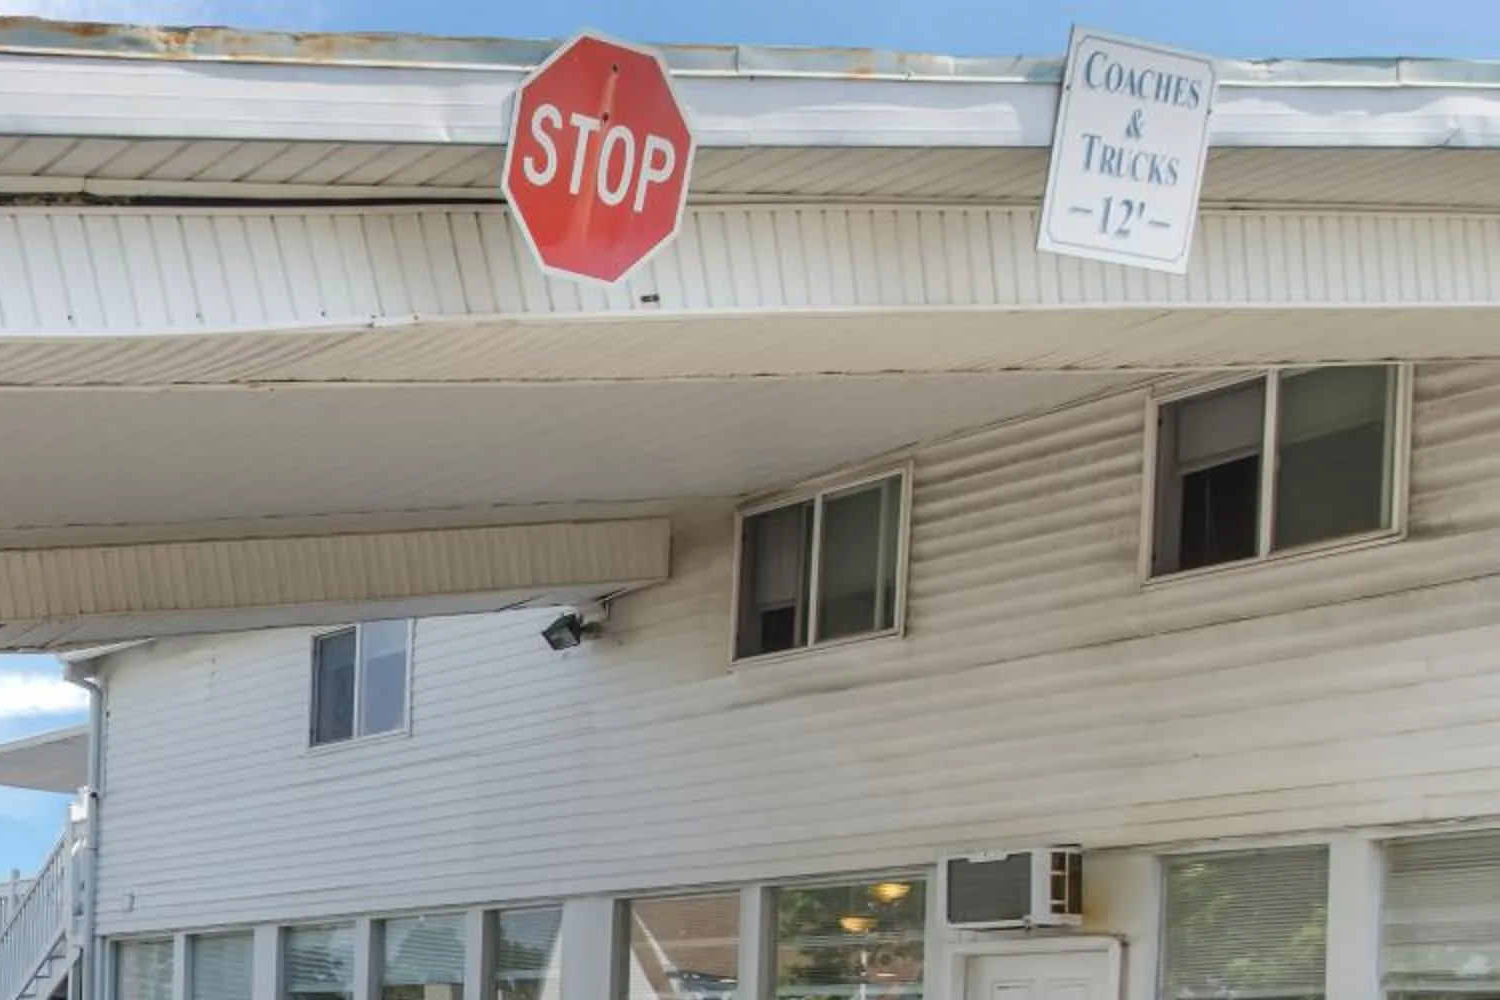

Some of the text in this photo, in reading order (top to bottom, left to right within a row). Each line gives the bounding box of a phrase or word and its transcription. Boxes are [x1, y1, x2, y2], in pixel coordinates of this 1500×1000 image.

[1085, 51, 1201, 109] COACHES
[1125, 109, 1144, 140] &
[523, 103, 675, 214] STOP
[1082, 133, 1181, 186] TRUCKS
